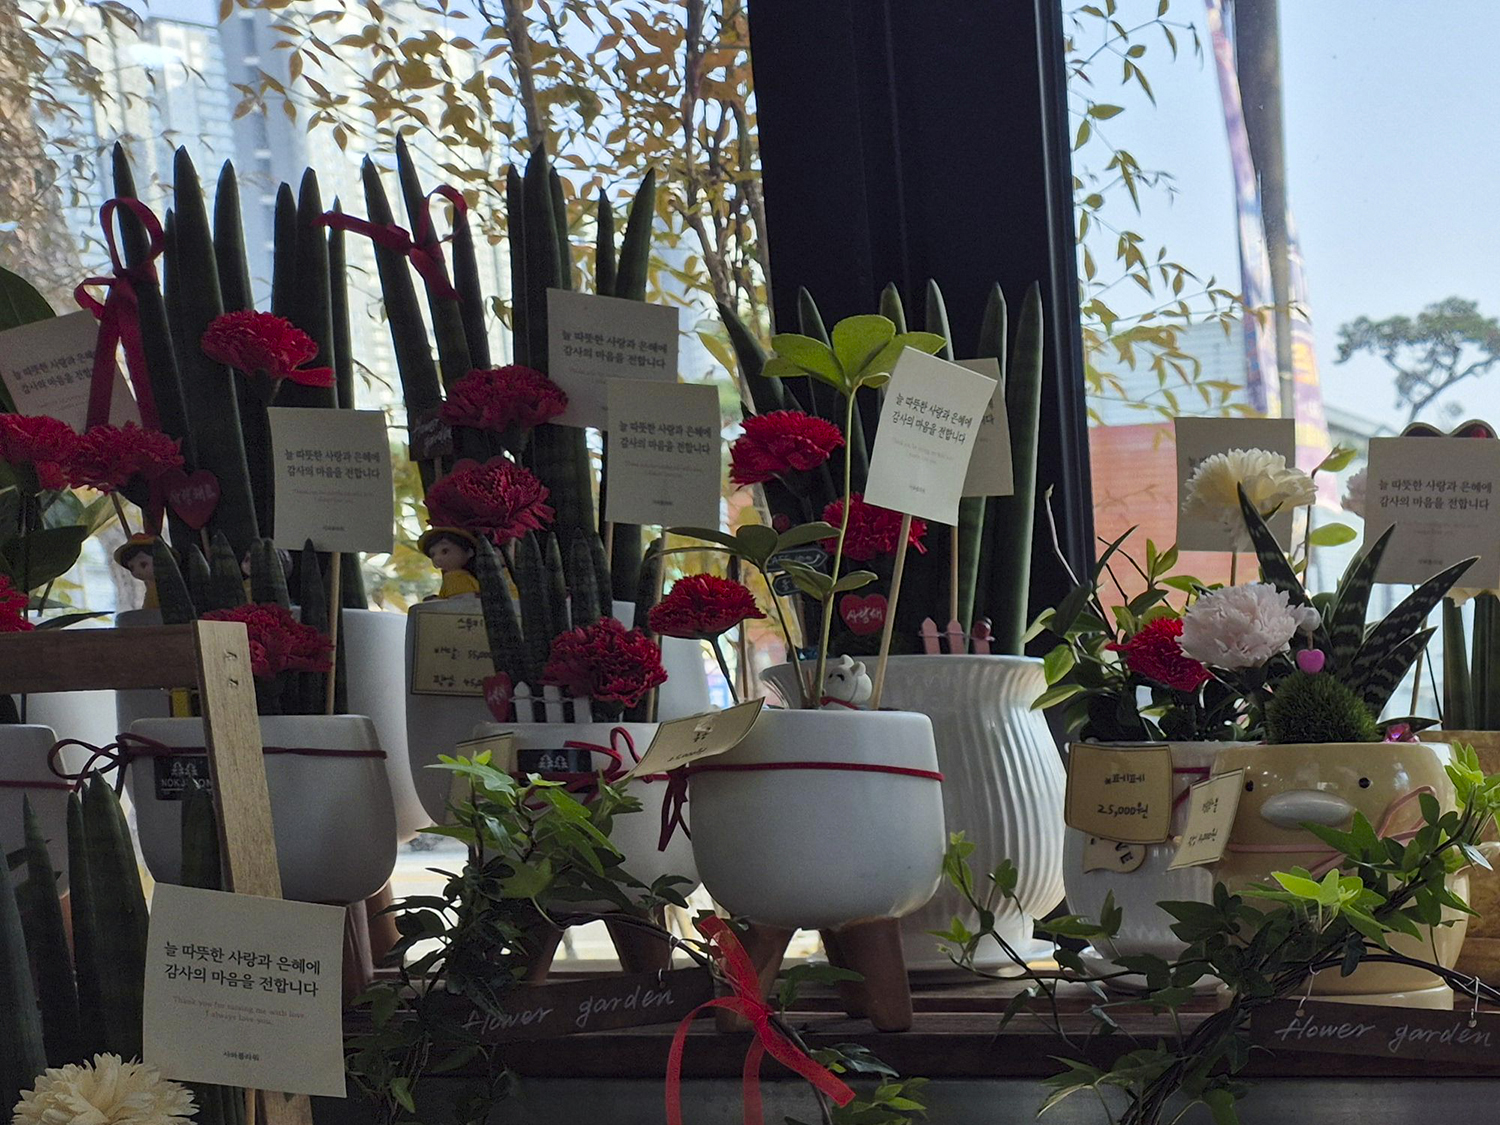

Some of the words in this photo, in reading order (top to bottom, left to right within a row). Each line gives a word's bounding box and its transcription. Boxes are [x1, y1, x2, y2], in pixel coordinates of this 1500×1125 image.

[562, 330, 571, 340] 늘
[575, 332, 604, 345] 따뜻한
[606, 335, 634, 349] 사랑과
[638, 339, 667, 354] 은혜에
[564, 345, 592, 359] 감사의
[596, 349, 624, 364] 마음을
[628, 354, 665, 369] 전합니다
[896, 394, 904, 405] 늘
[906, 396, 928, 412] 따뜻한
[929, 402, 950, 421] 사랑과
[951, 411, 972, 428] 은혜에
[619, 420, 626, 431] 늘
[630, 422, 656, 434] 따뜻한
[658, 423, 682, 436] 사랑과
[687, 426, 712, 439] 은혜에
[892, 412, 915, 428] 감사의
[916, 419, 936, 436] 마음을
[939, 426, 966, 444] 전합니다
[285, 449, 294, 460] 늘
[296, 450, 322, 460] 따뜻한
[326, 450, 351, 462] 사랑과
[354, 451, 380, 463] 은혜에
[622, 438, 646, 450] 감사의
[649, 439, 674, 452] 마음을
[678, 442, 710, 454] 전합니다
[288, 465, 314, 478] 감사의
[317, 467, 342, 479] 마음을
[347, 468, 380, 480] 전합니다
[1379, 480, 1388, 490] 늘
[1392, 480, 1422, 492] 따뜻한
[1426, 480, 1457, 492] 사랑과
[1460, 480, 1492, 494] 은혜에
[1380, 496, 1410, 508] 감사의
[1412, 496, 1444, 510] 마음을
[1448, 497, 1490, 510] 전합니다
[1097, 802, 1149, 819] 25,000원
[164, 942, 178, 958] 늘
[183, 944, 224, 964] 따뜻한
[228, 950, 272, 971] 사랑과
[276, 955, 321, 976] 은혜에
[164, 964, 207, 984] 감사의
[212, 969, 255, 990] 마음을
[260, 976, 320, 998] 전합니다
[575, 985, 675, 1029] garden
[1274, 1015, 1376, 1045] flower
[1388, 1021, 1492, 1053] garden
